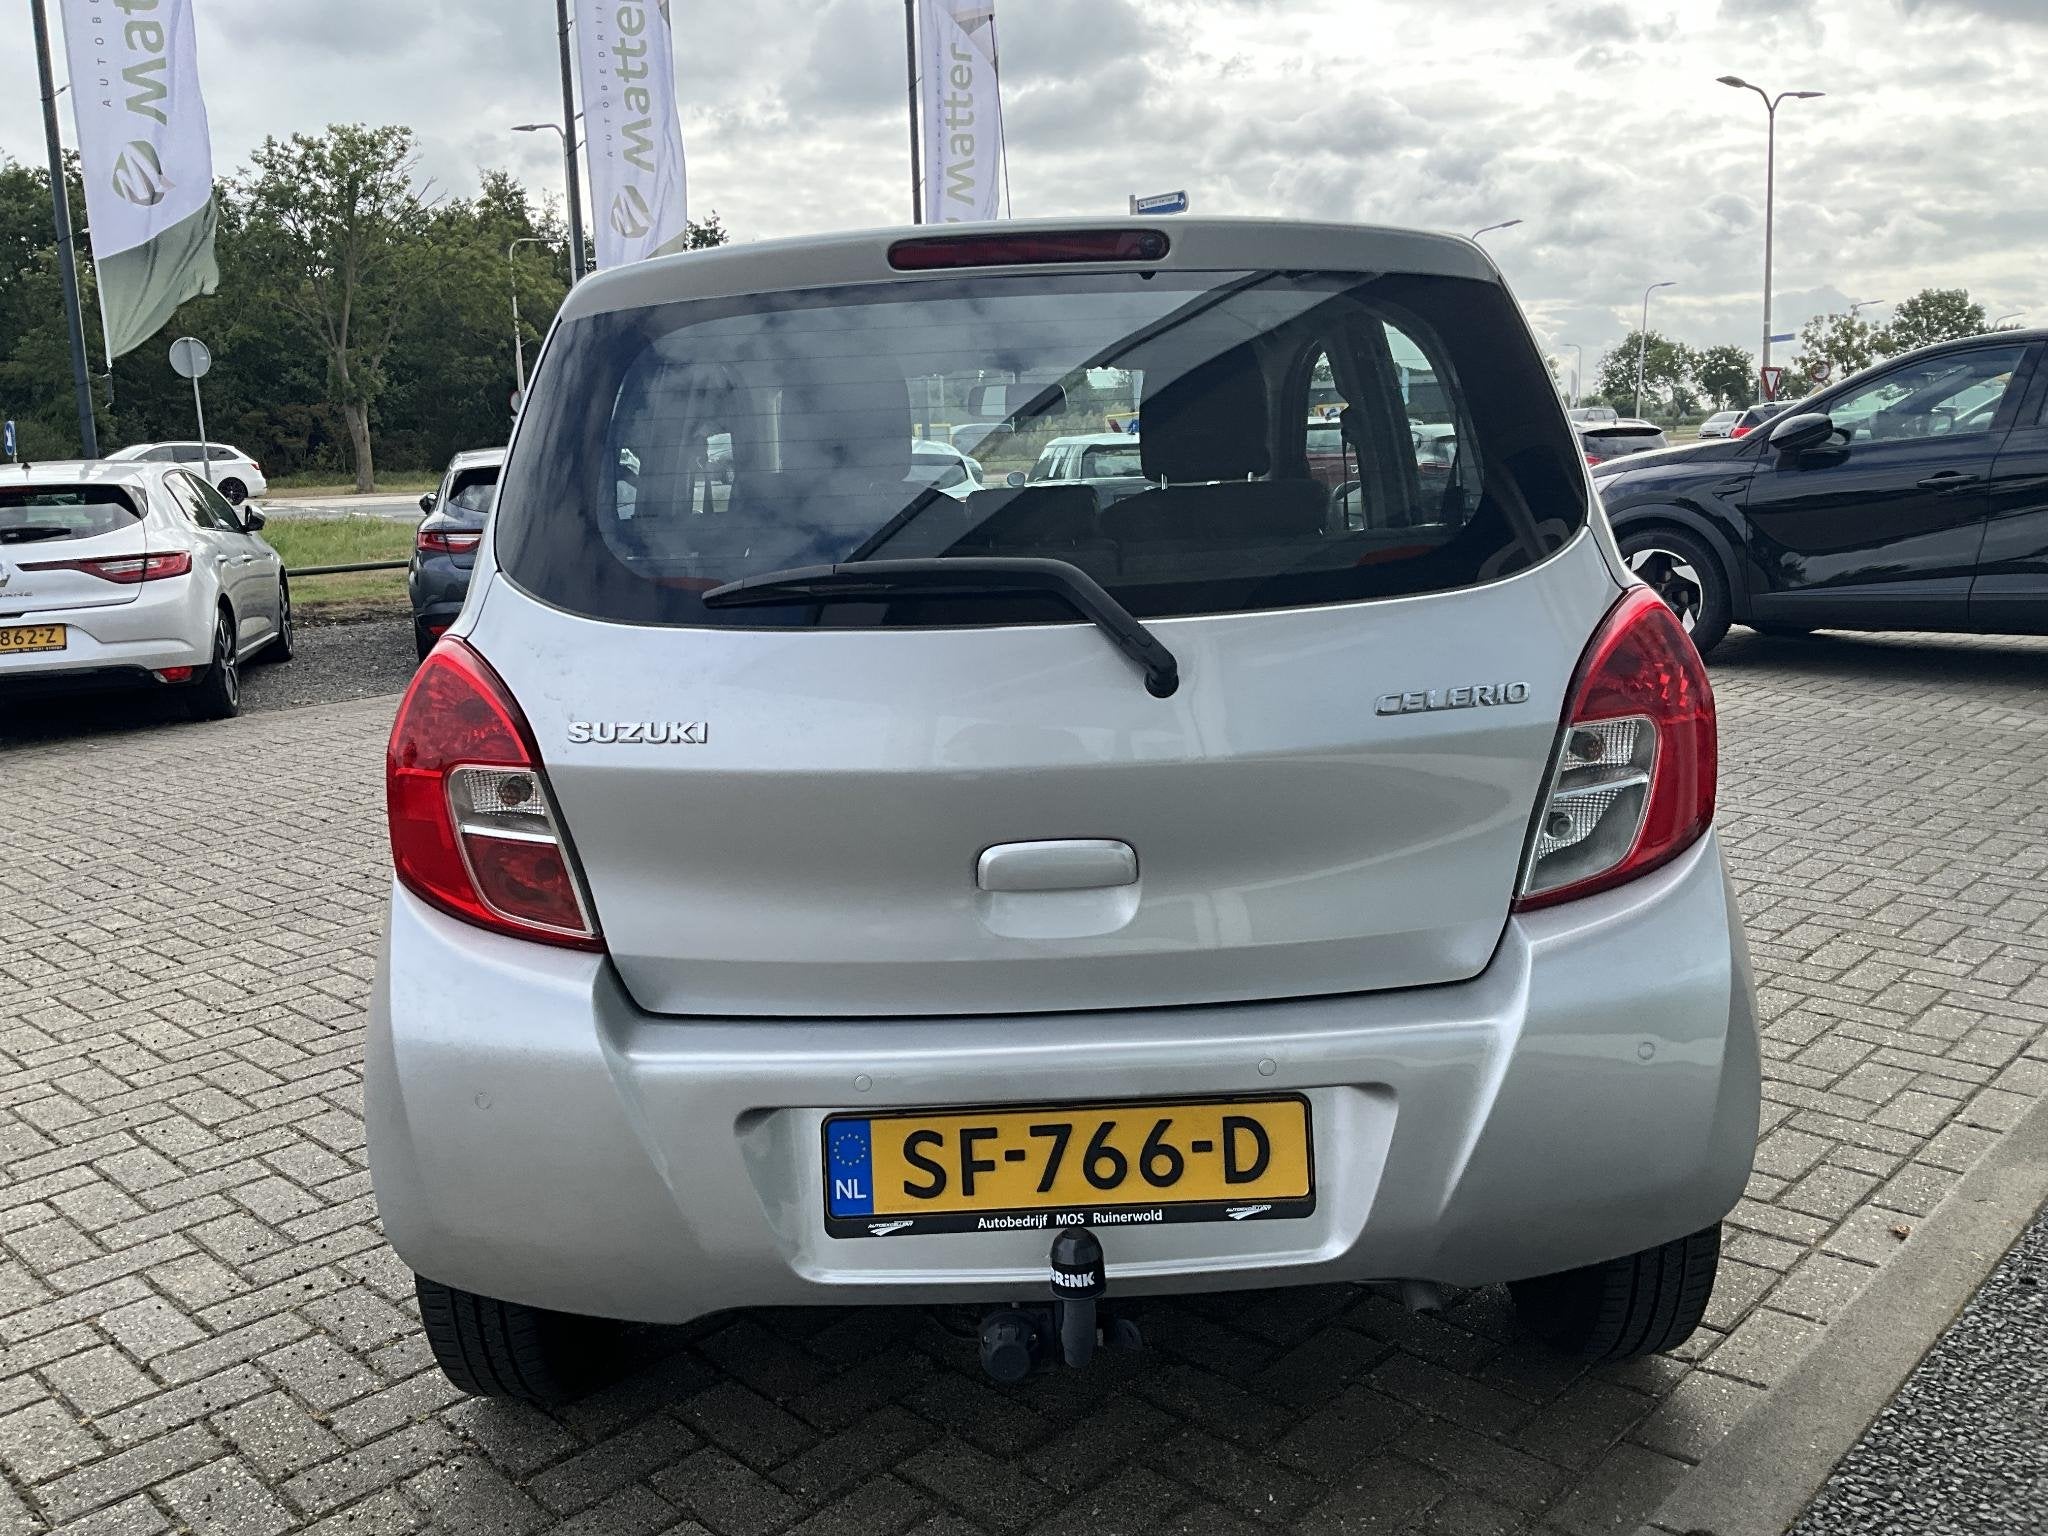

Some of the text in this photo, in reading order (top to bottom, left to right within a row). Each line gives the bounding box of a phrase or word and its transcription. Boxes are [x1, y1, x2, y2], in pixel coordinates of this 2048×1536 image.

[611, 0, 655, 173] Matte
[944, 43, 976, 207] Matter
[0, 627, 57, 646] 862-Z
[1376, 681, 1530, 716] CELERIO
[567, 720, 708, 744] SUZUKI
[902, 1115, 1271, 1200] SF-766-D
[836, 1178, 867, 1200] NL
[977, 1208, 1164, 1230] Autobedrijf MOS Ruinerwold
